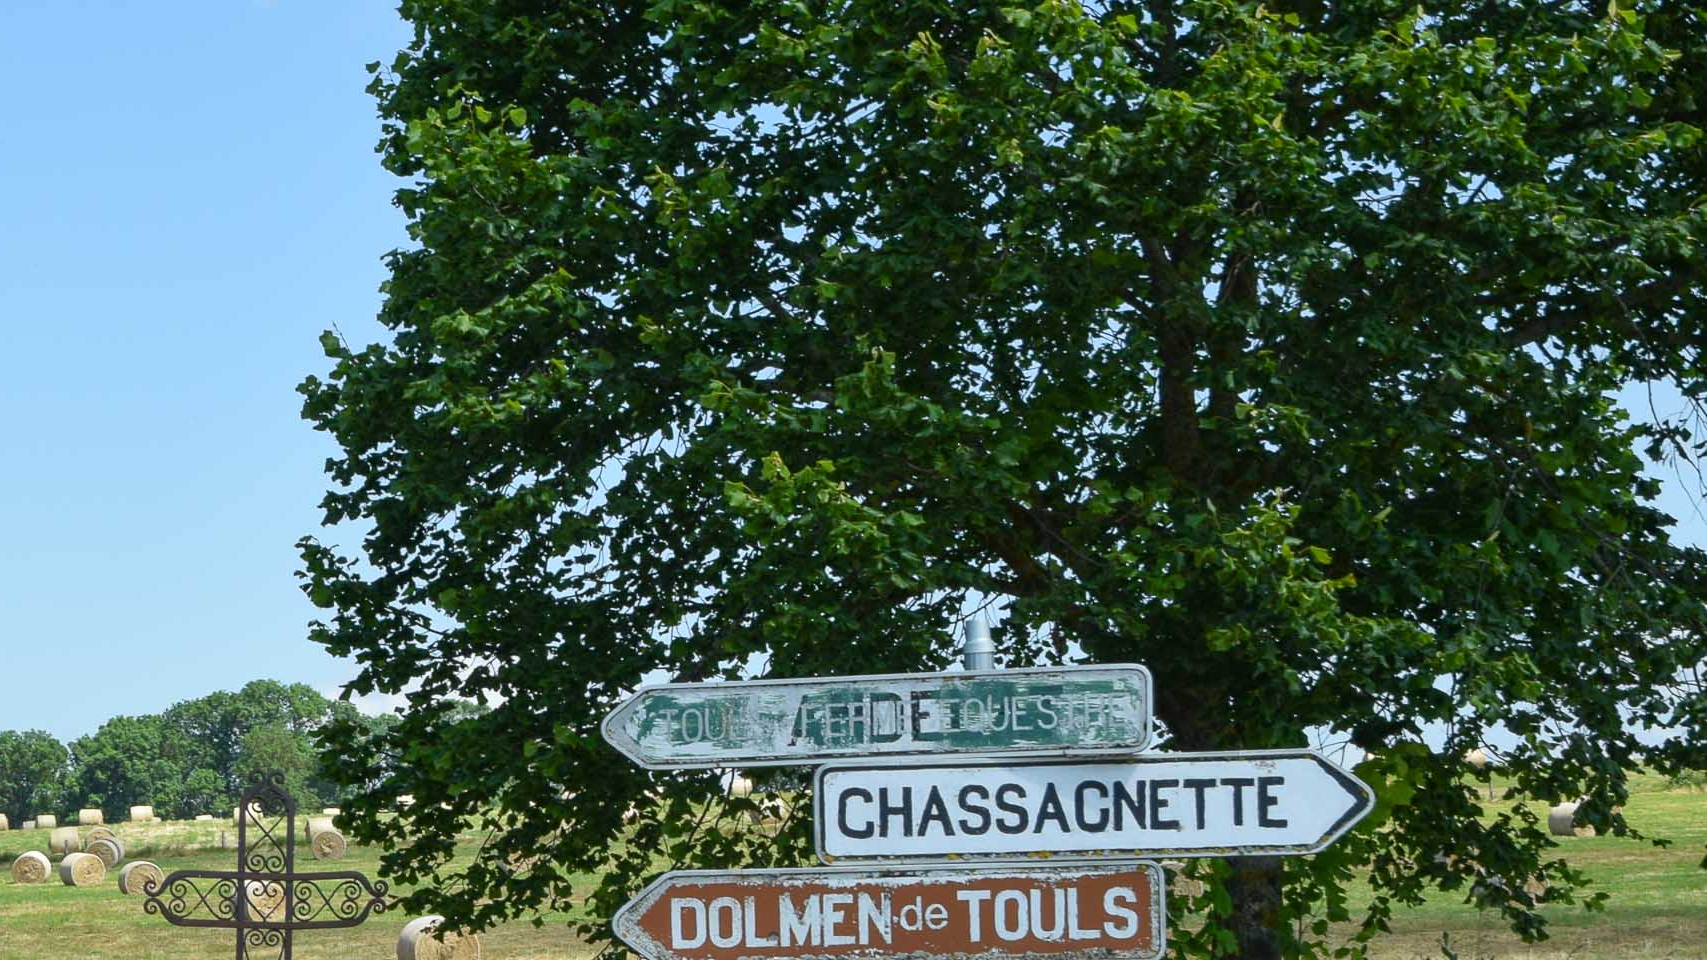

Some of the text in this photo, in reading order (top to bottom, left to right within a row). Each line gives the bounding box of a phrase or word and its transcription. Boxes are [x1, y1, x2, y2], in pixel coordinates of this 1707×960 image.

[671, 886, 1139, 954] DOLMEN de TOULS
